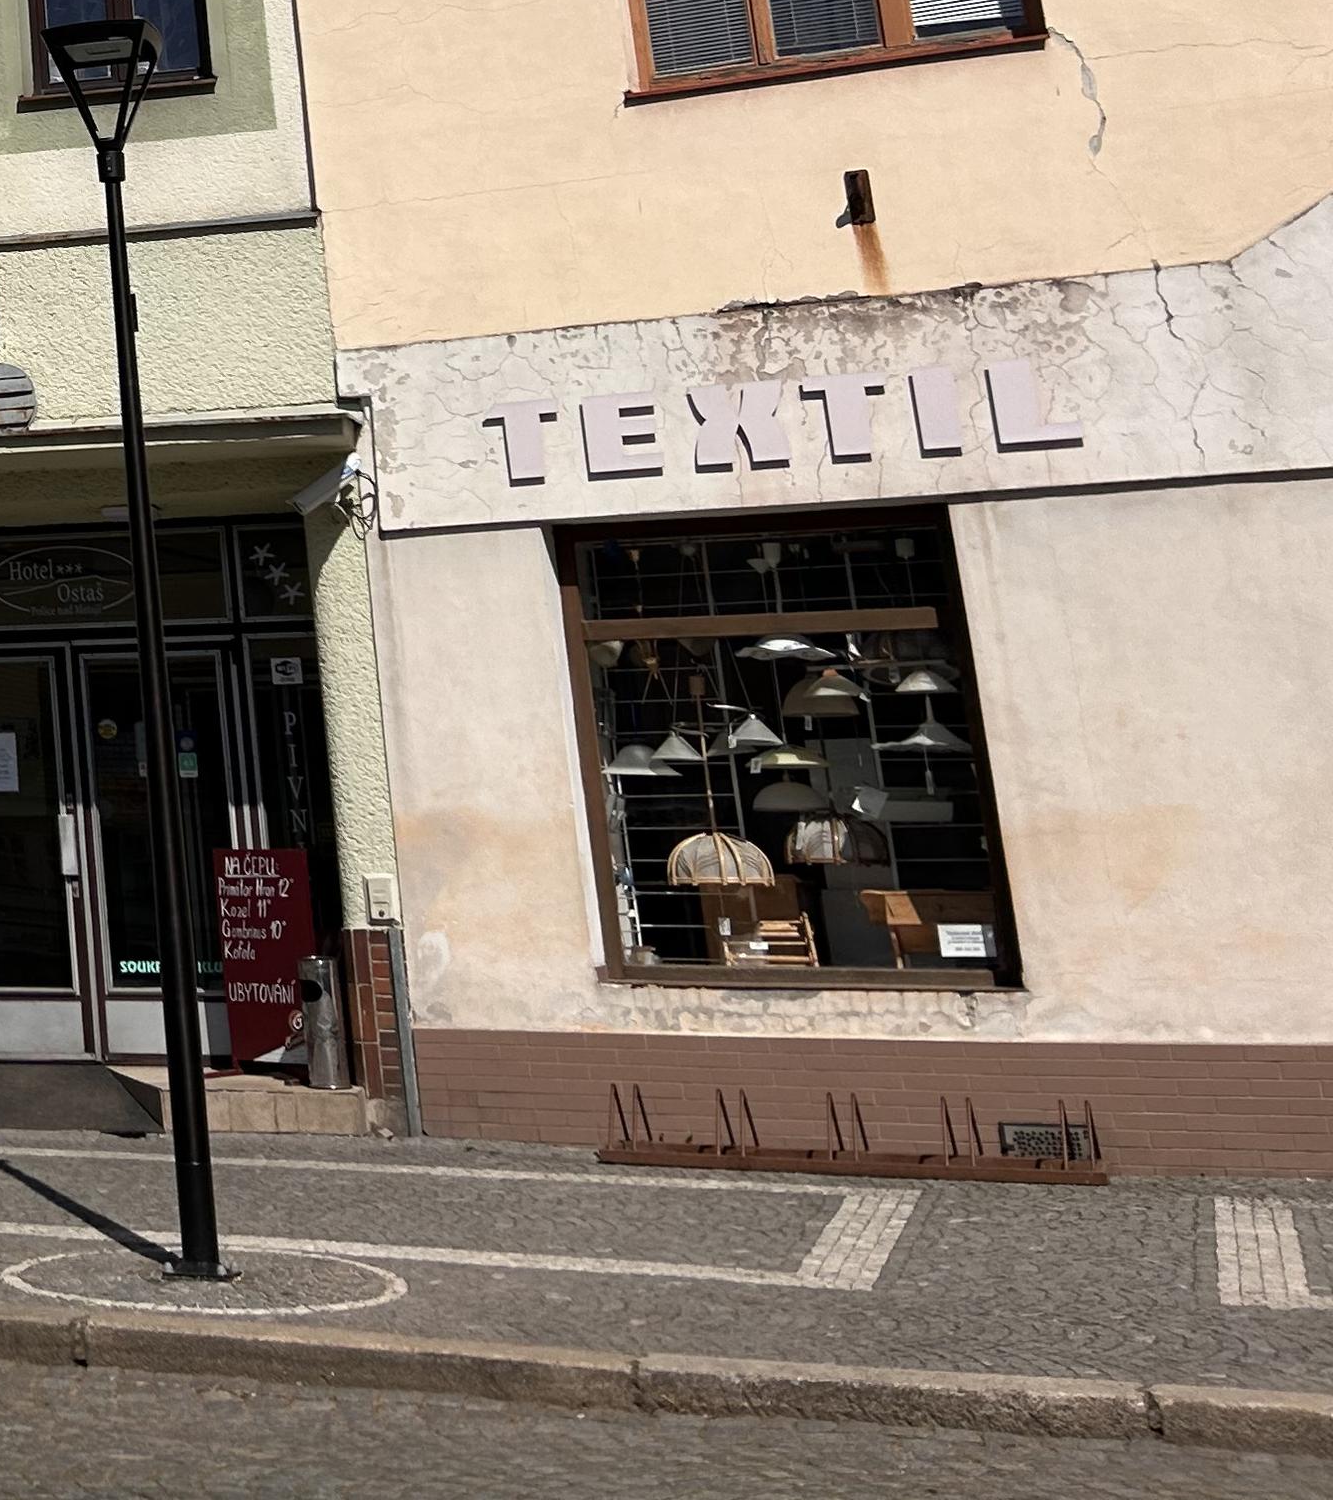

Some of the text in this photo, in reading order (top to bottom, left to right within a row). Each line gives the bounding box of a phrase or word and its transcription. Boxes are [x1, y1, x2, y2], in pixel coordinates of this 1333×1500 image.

[482, 359, 1084, 486] TEXTIL
[9, 558, 55, 581] Hotel
[57, 581, 105, 603] Ostaš
[283, 711, 308, 845] PIVN
[225, 855, 240, 875] NA
[220, 898, 251, 918] Kozel
[201, 960, 224, 973] KLU
[228, 977, 296, 1004] UBYTOVÁNÍ
